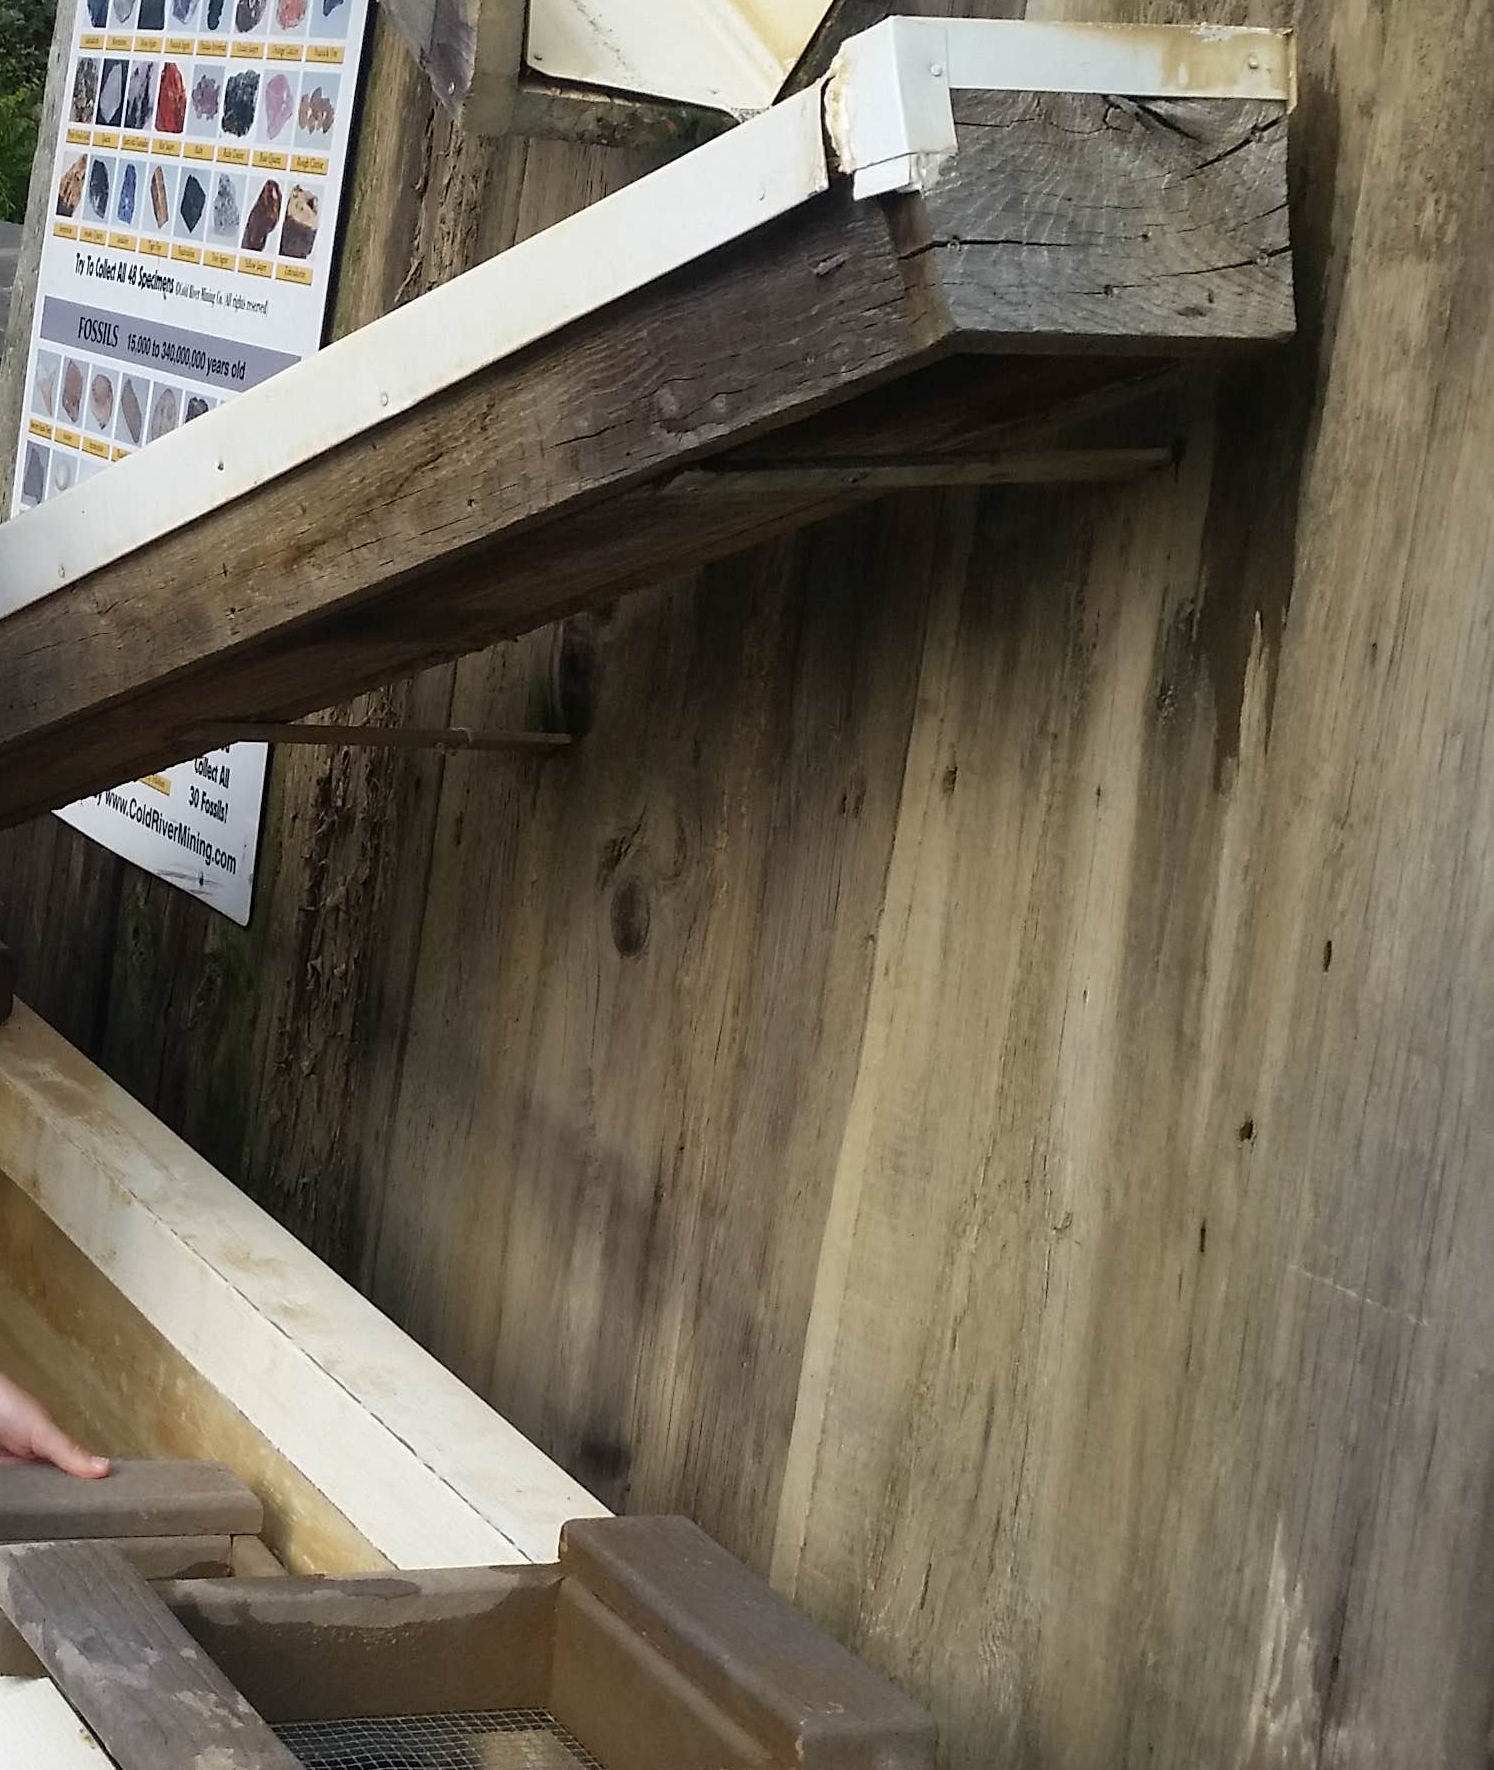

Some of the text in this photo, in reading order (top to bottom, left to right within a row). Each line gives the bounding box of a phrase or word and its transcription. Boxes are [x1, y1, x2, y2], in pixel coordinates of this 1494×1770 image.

[75, 252, 85, 276] Try
[86, 255, 94, 276] To
[96, 256, 116, 281] Collect
[117, 261, 127, 283] All
[128, 264, 137, 285] 48
[138, 265, 174, 294] Specimens
[78, 316, 119, 347] FOSSILS
[152, 340, 160, 358] to
[206, 356, 229, 376] years
[231, 361, 246, 380] old
[194, 756, 218, 784] Collect
[219, 765, 230, 789] All
[188, 785, 229, 824] 30 Fossils!
[105, 790, 237, 875] www.ColdRiverMining.com
